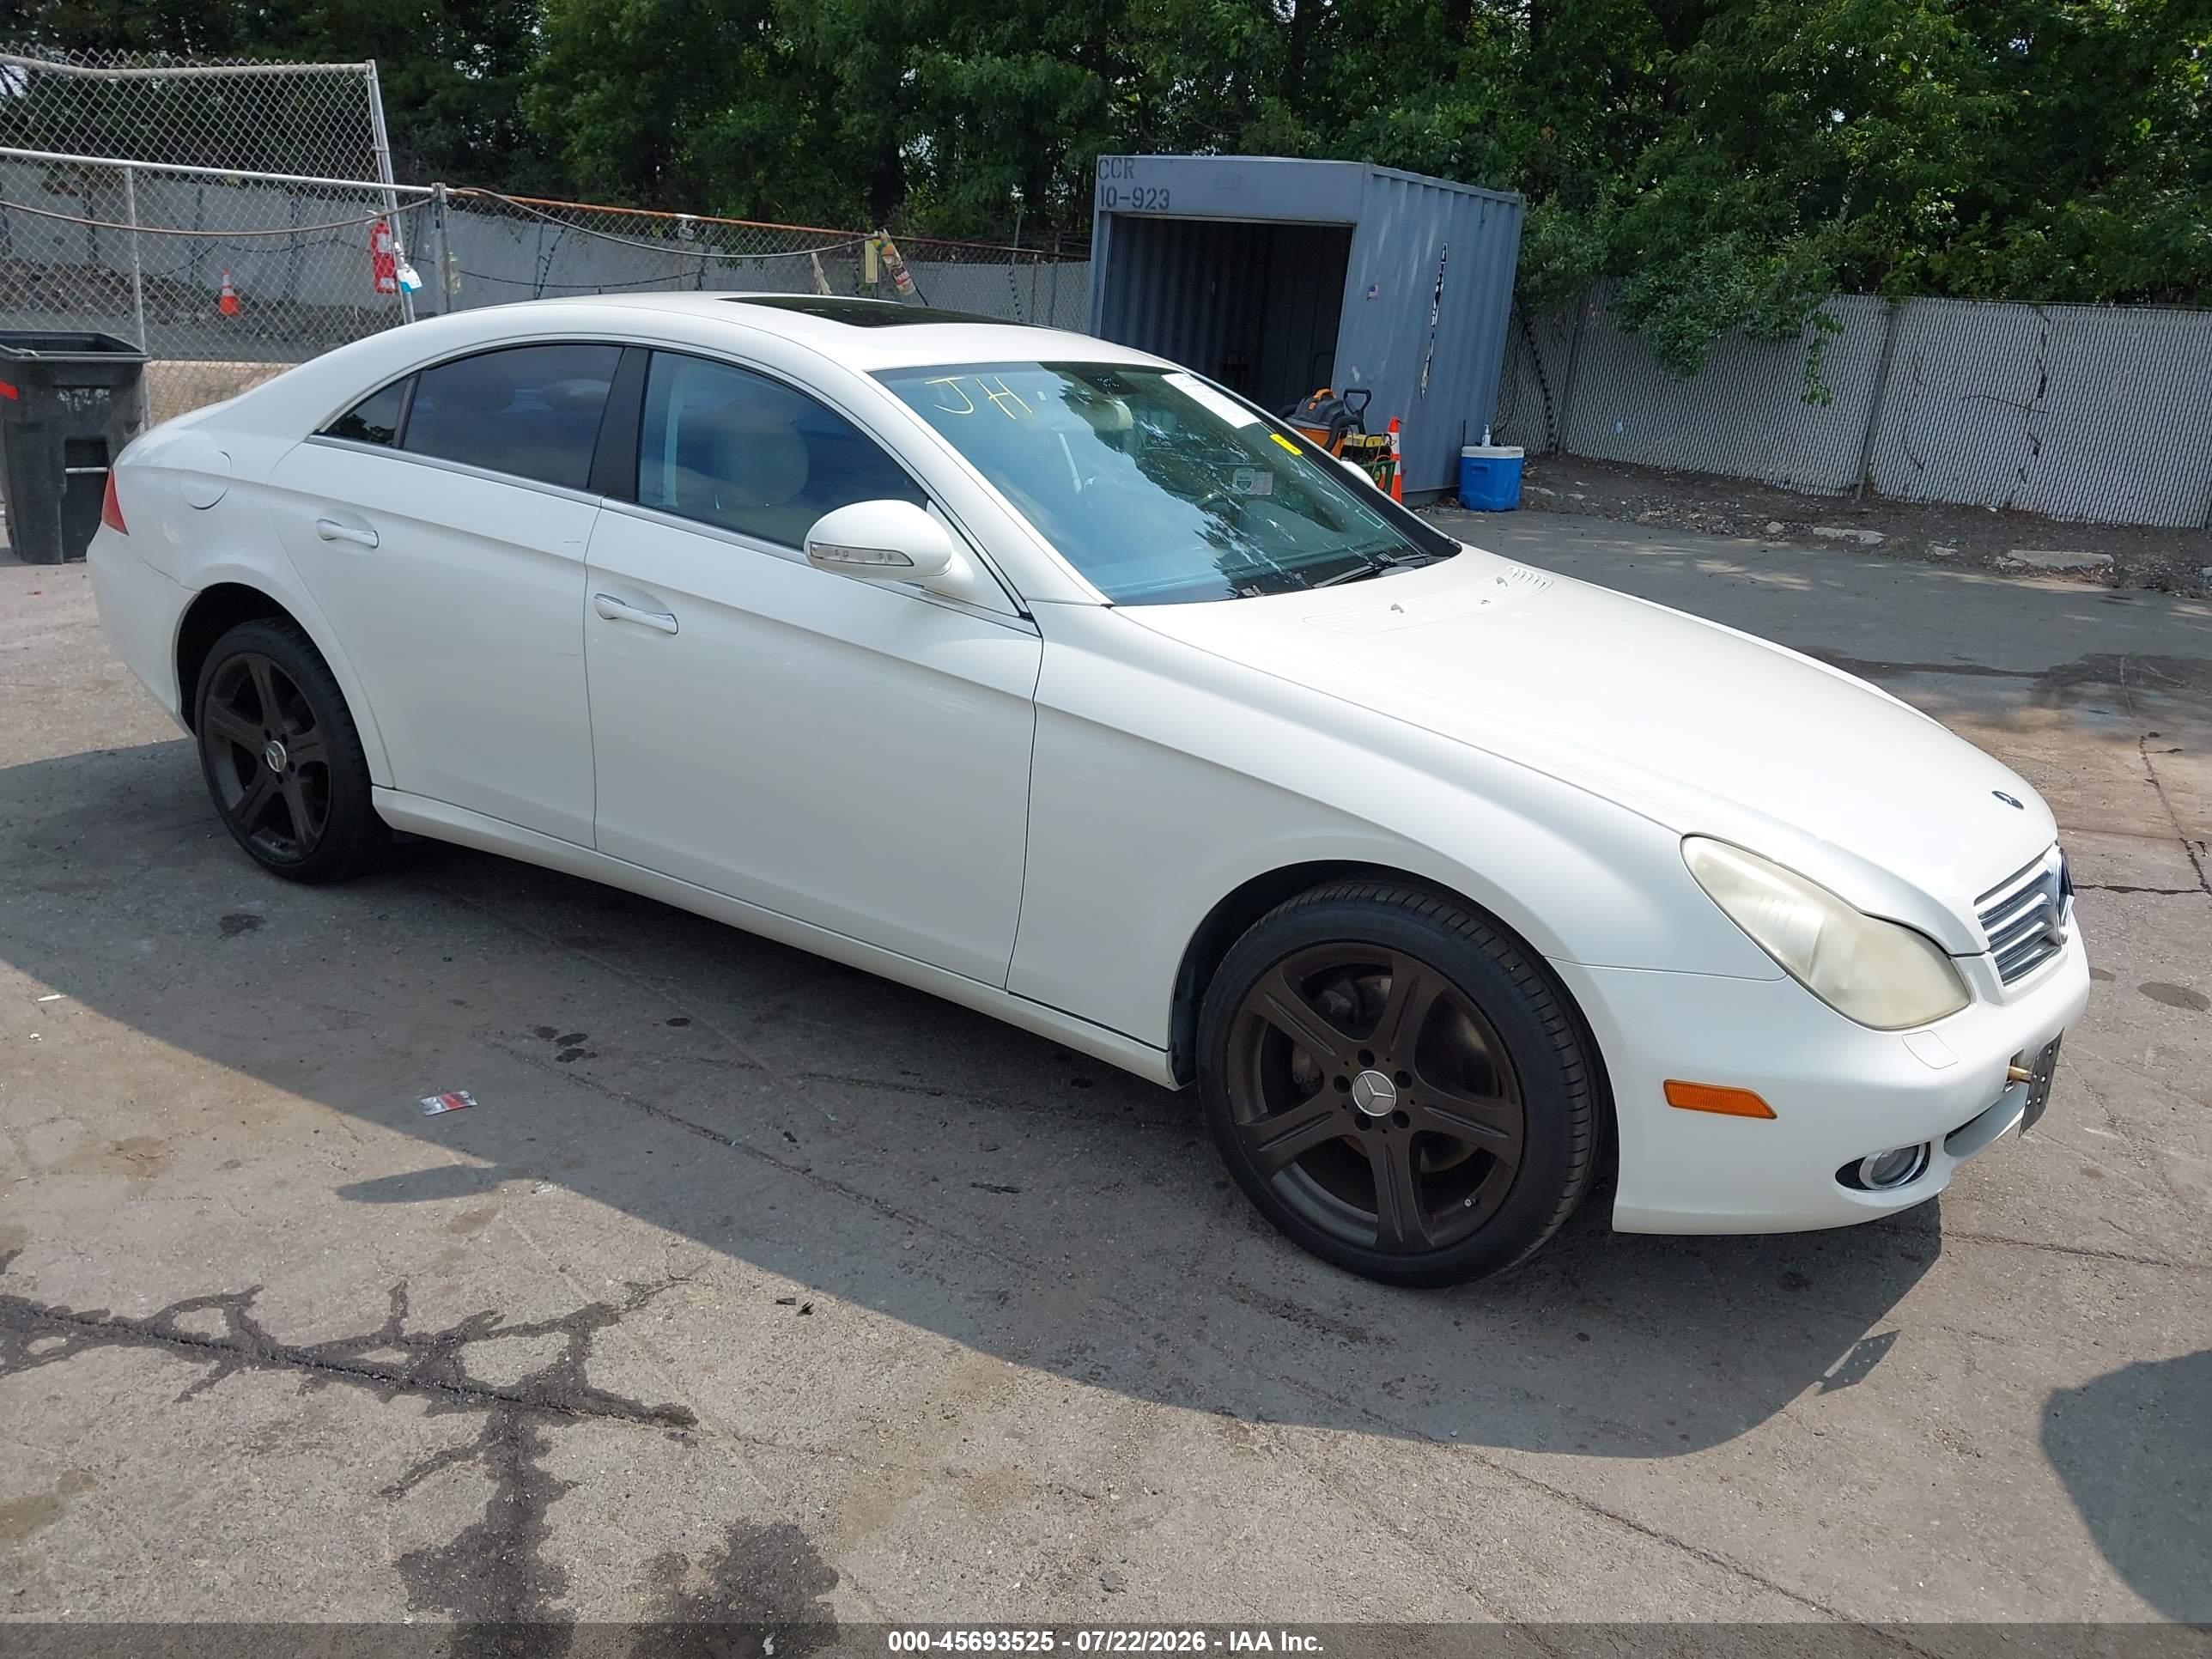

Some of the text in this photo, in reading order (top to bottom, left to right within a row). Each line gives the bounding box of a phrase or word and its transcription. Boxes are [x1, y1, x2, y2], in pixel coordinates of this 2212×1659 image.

[1097, 157, 1135, 180] CCR
[1100, 185, 1170, 210] 10-923
[924, 376, 1032, 420] JH
